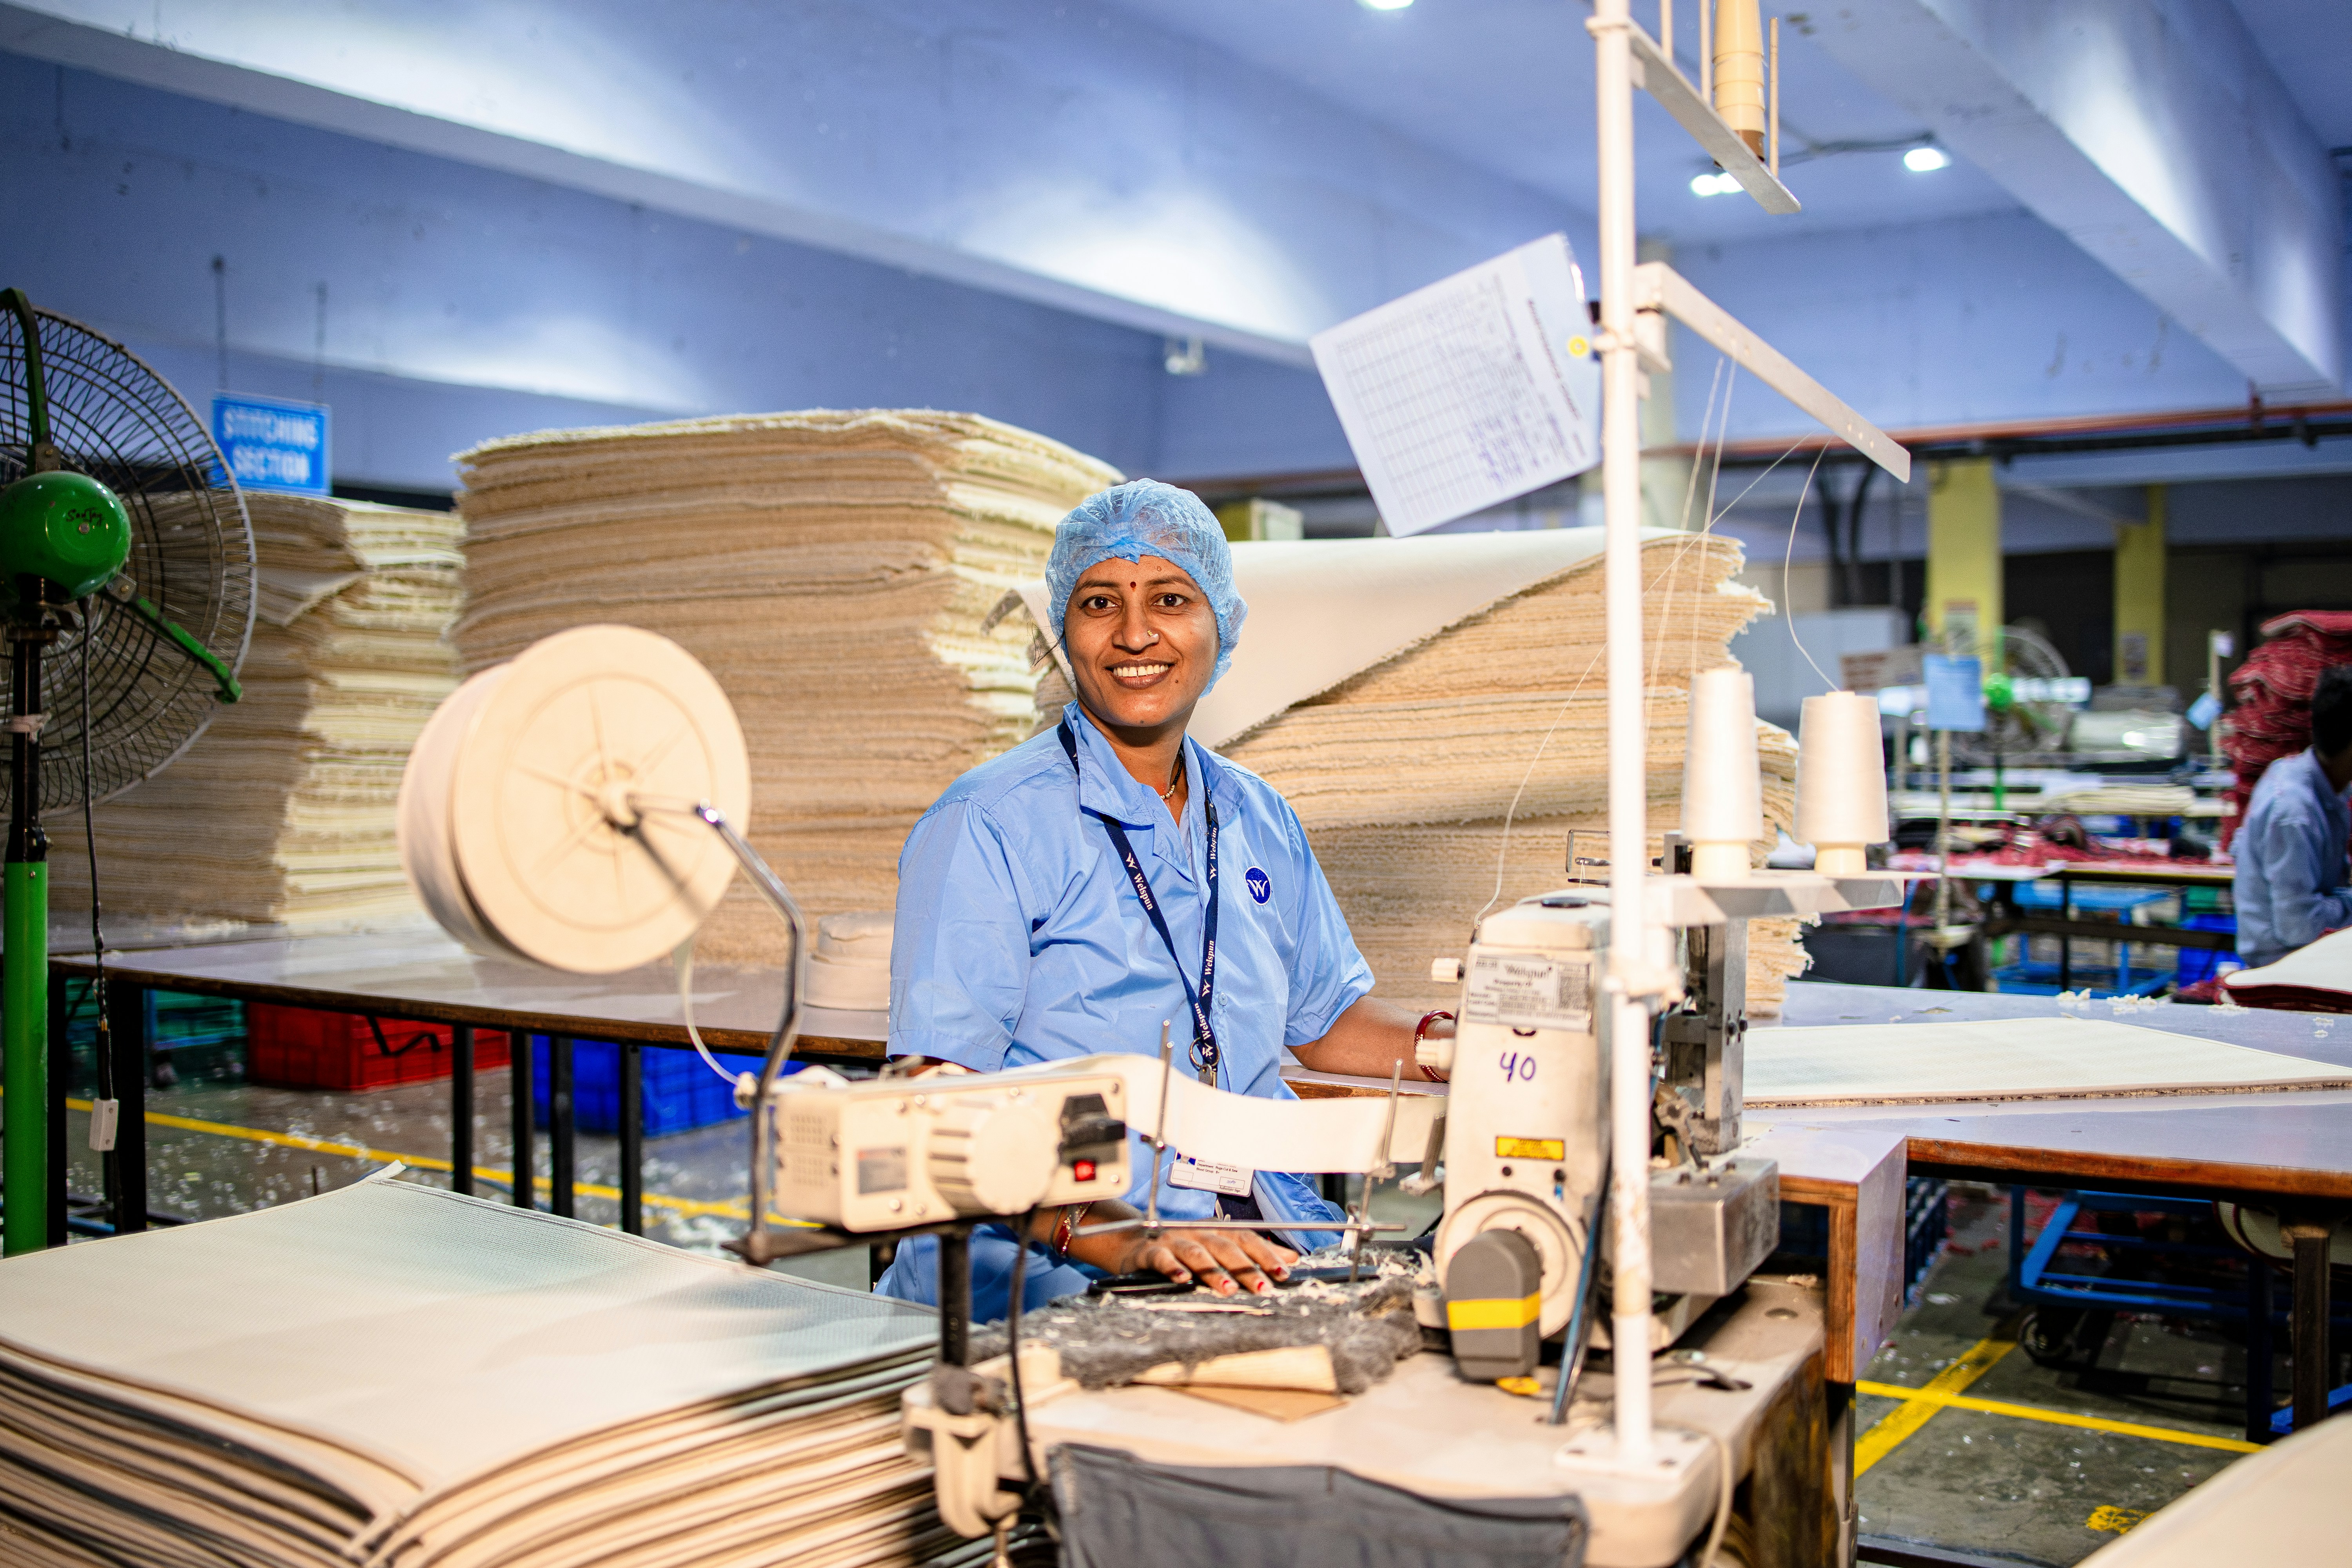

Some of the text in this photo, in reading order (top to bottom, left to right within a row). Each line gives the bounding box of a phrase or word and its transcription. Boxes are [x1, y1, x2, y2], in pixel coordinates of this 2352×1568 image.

[1134, 873, 1153, 910] Welspun
[1205, 940, 1214, 975] Welspun
[1194, 1003, 1211, 1040] Welspun
[1499, 1052, 1537, 1082] 40
